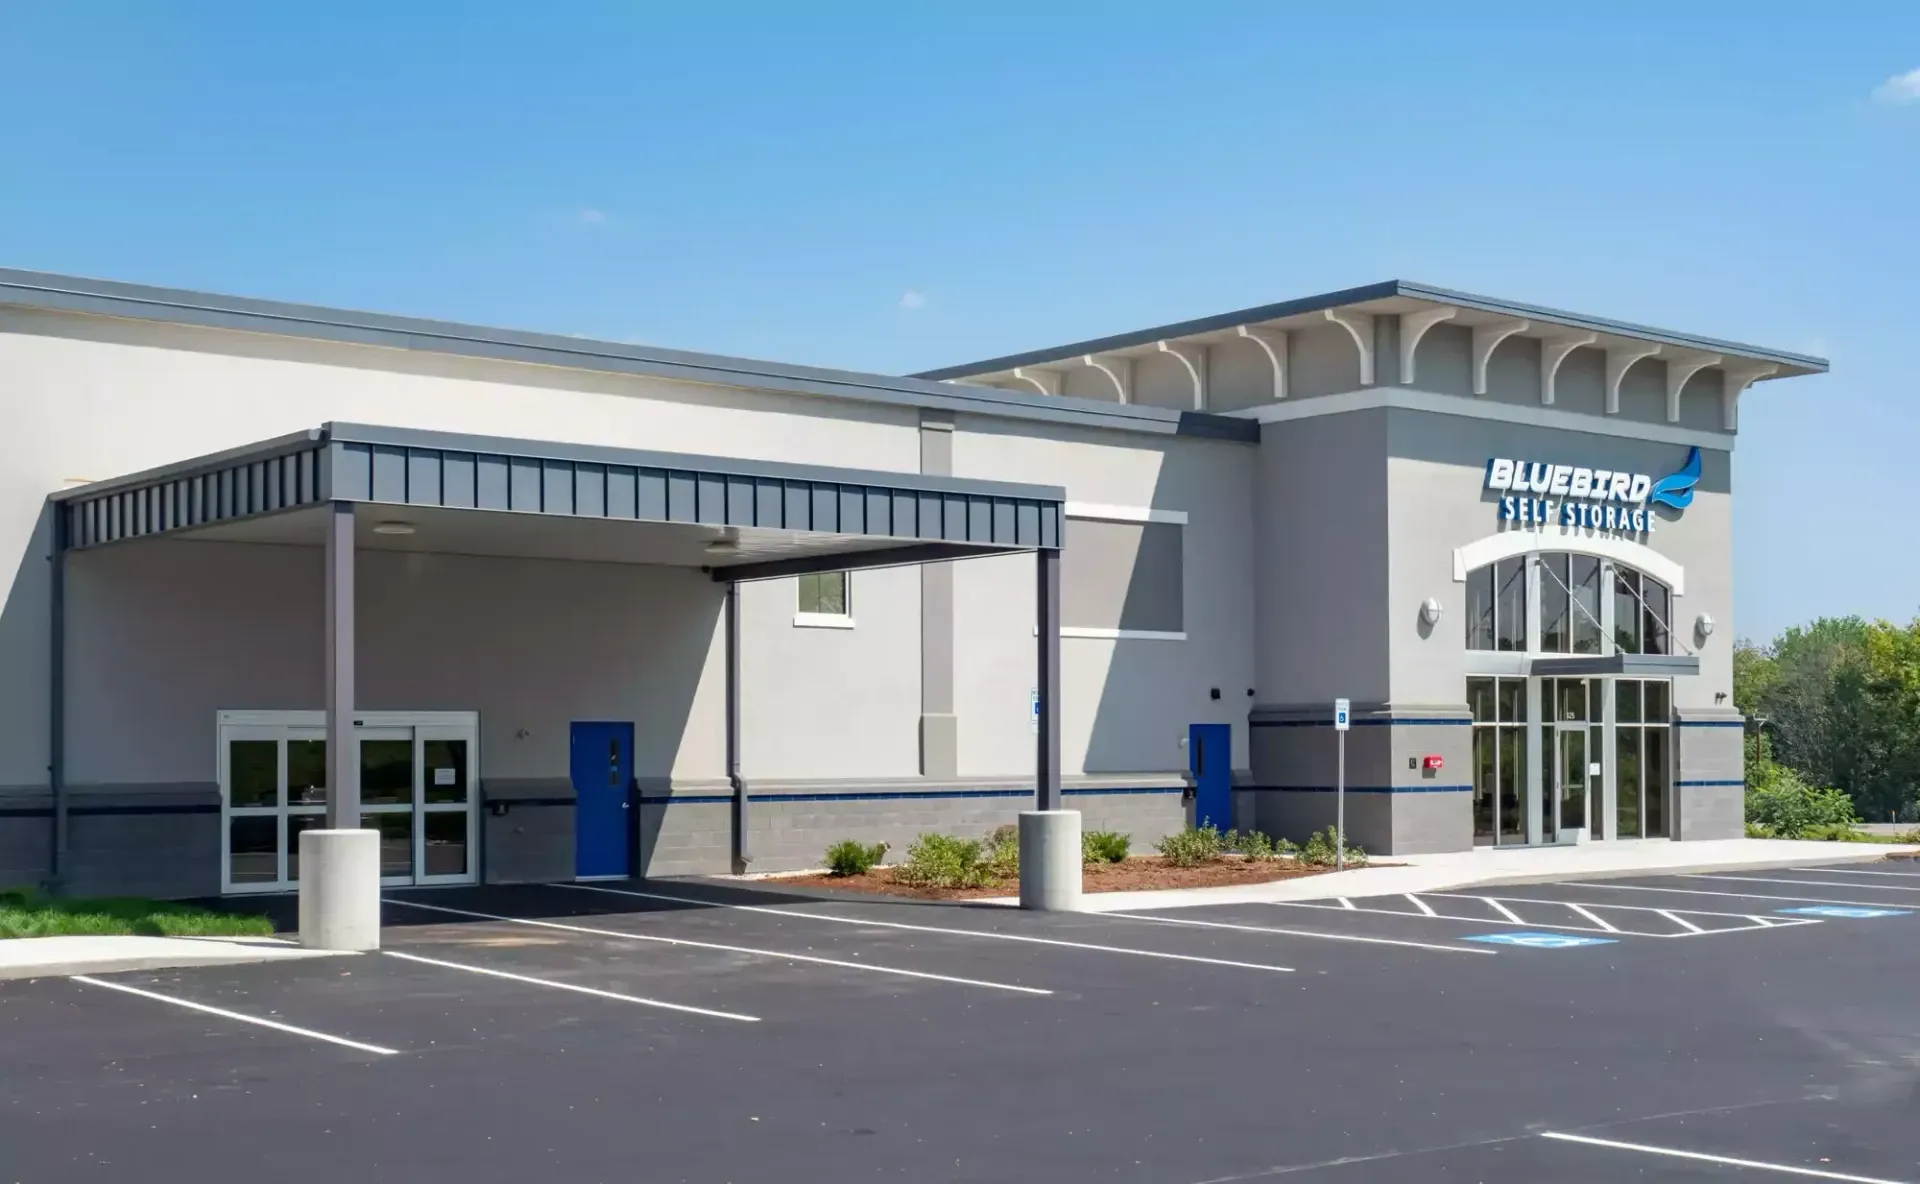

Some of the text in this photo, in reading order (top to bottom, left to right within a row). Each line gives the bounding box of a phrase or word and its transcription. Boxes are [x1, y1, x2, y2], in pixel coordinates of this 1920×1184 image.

[1487, 458, 1651, 503] BLUEBIRD
[1503, 496, 1656, 533] SELF STORAGE
